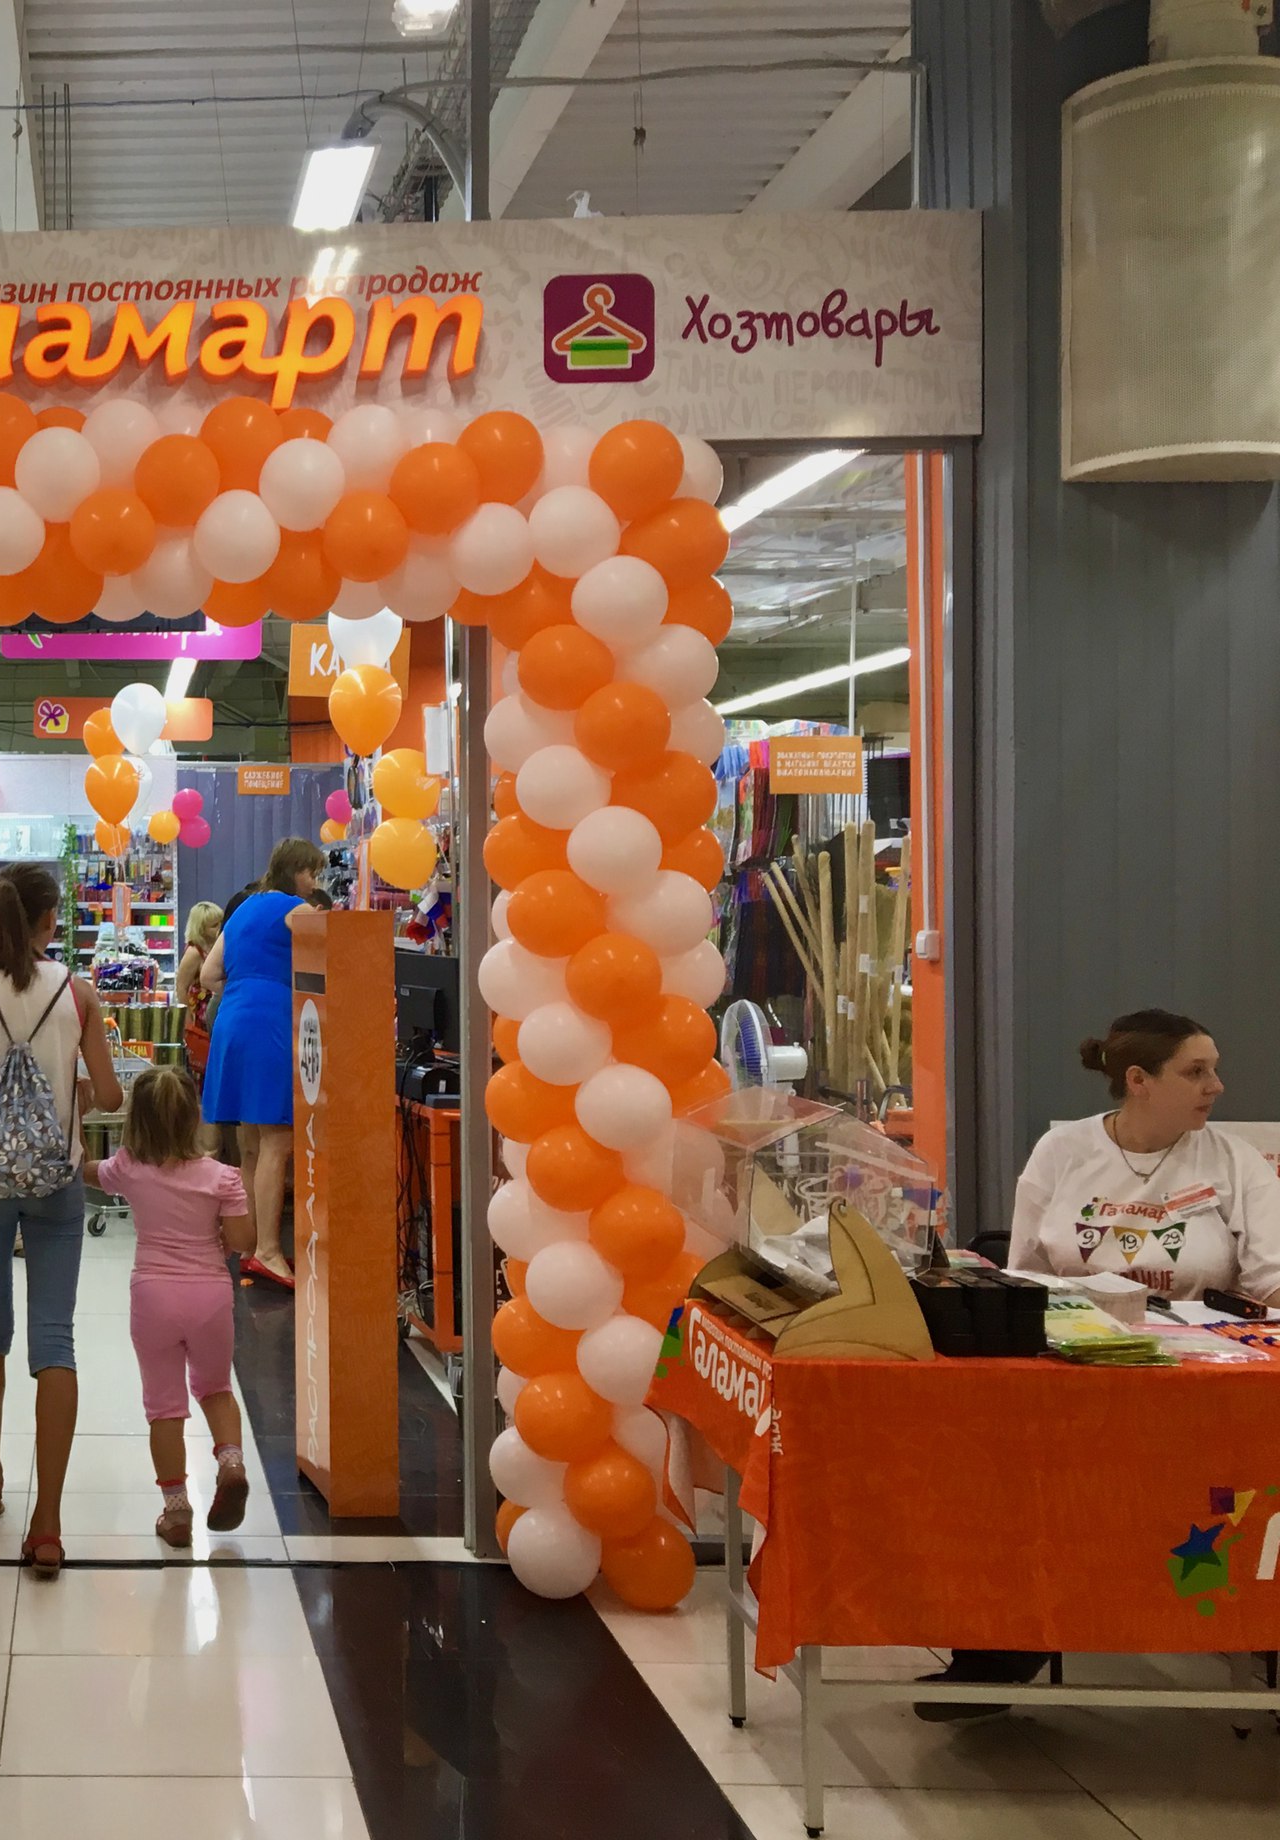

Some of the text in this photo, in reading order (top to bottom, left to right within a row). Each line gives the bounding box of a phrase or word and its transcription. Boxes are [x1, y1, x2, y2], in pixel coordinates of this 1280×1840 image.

[66, 276, 281, 303] постоянных
[681, 288, 941, 368] Хозтовары
[1098, 1202, 1168, 1223] Гаамар
[1120, 1234, 1138, 1250] 19
[1162, 1231, 1181, 1247] 29
